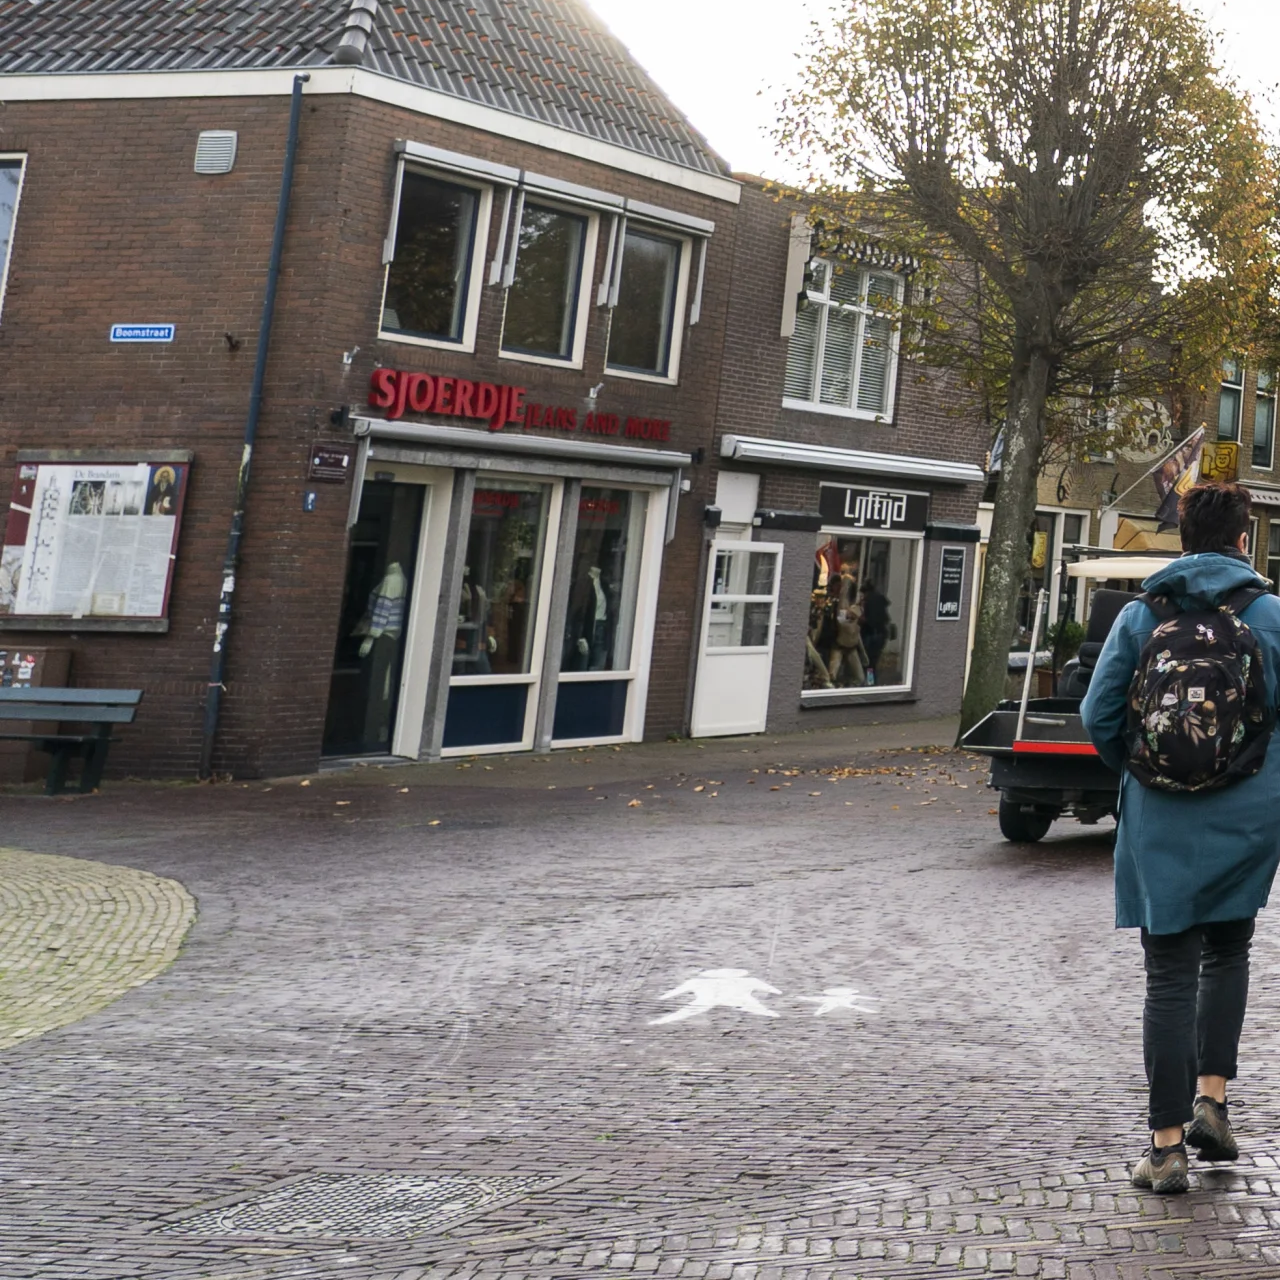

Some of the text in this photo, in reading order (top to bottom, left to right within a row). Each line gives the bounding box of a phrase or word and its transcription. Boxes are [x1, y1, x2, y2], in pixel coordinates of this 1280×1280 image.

[115, 328, 169, 337] Boomstraat
[368, 368, 672, 442] SJOERDJE JEANS AND MORE
